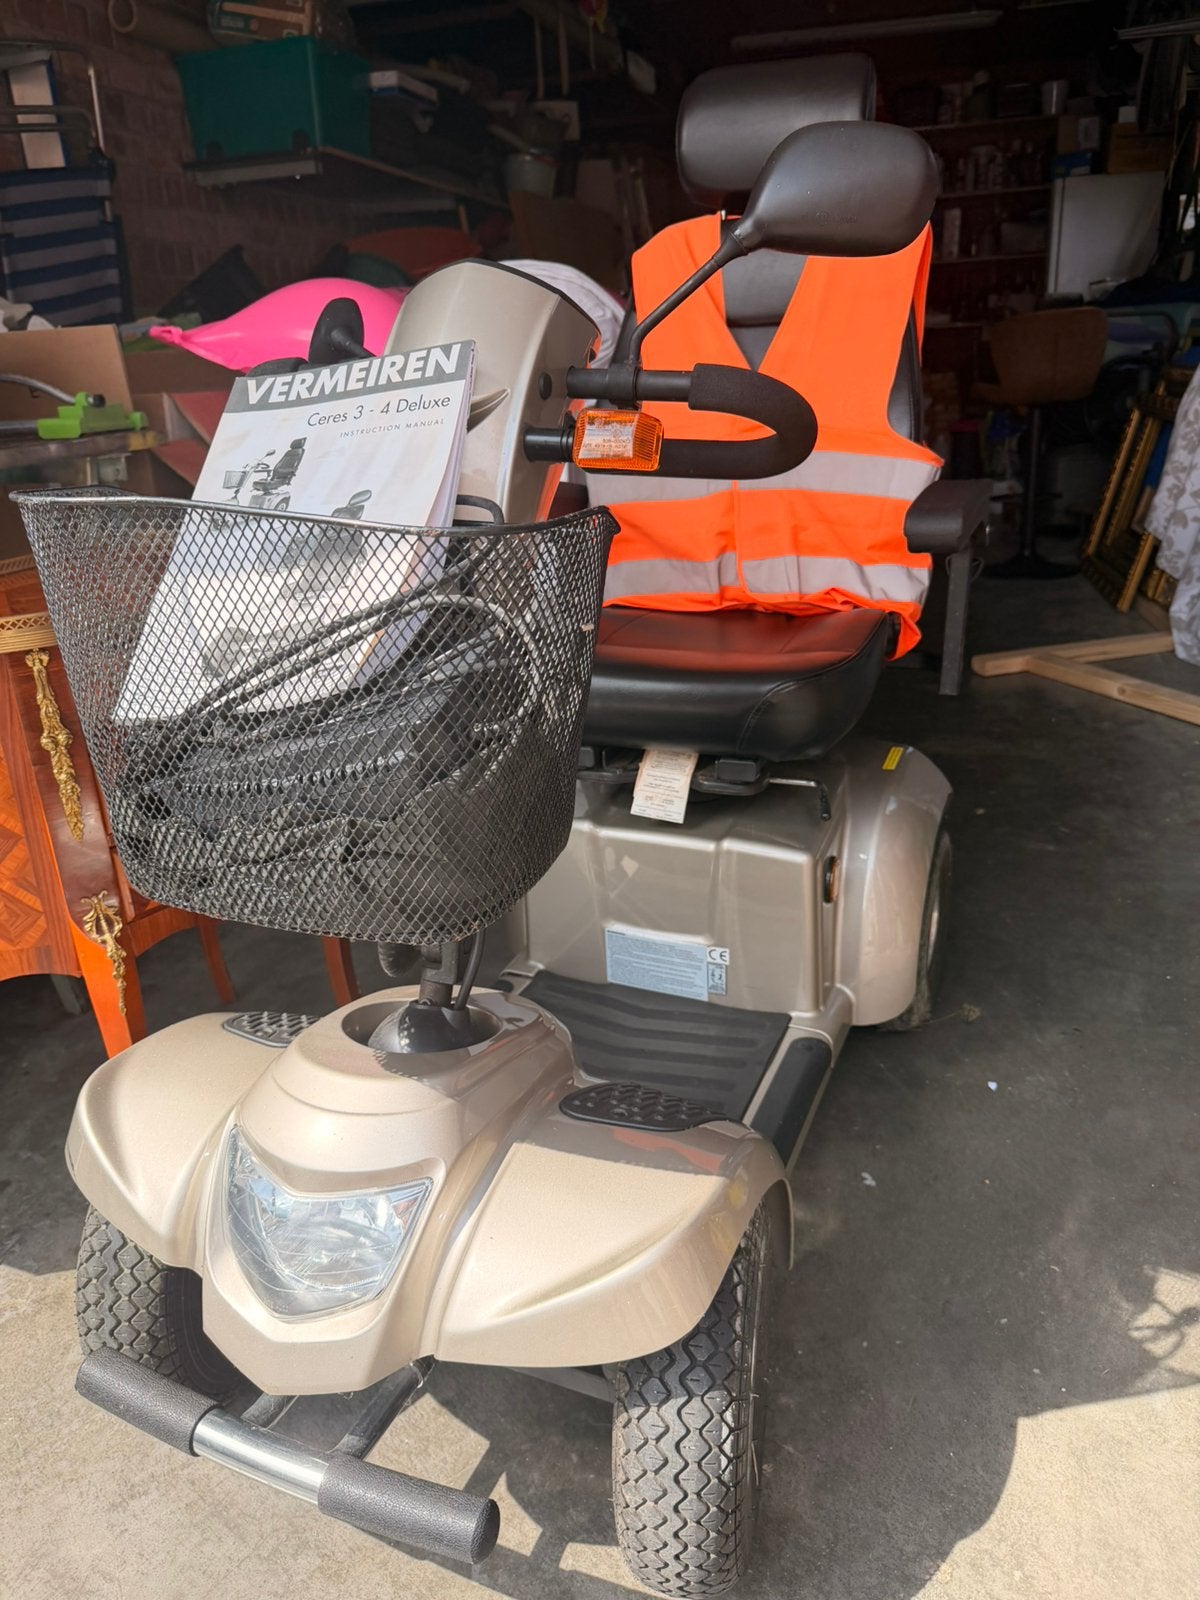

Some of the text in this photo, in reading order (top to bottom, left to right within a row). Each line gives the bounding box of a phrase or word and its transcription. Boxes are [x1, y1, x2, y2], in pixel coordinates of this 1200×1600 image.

[246, 344, 461, 405] VERMEIREN
[307, 412, 348, 427] Ceres
[353, 405, 363, 420] 3
[380, 402, 390, 415] 4
[396, 393, 451, 413] Deluxe
[339, 419, 445, 439] INSTRUCTION MANUAL
[708, 948, 728, 963] CE
